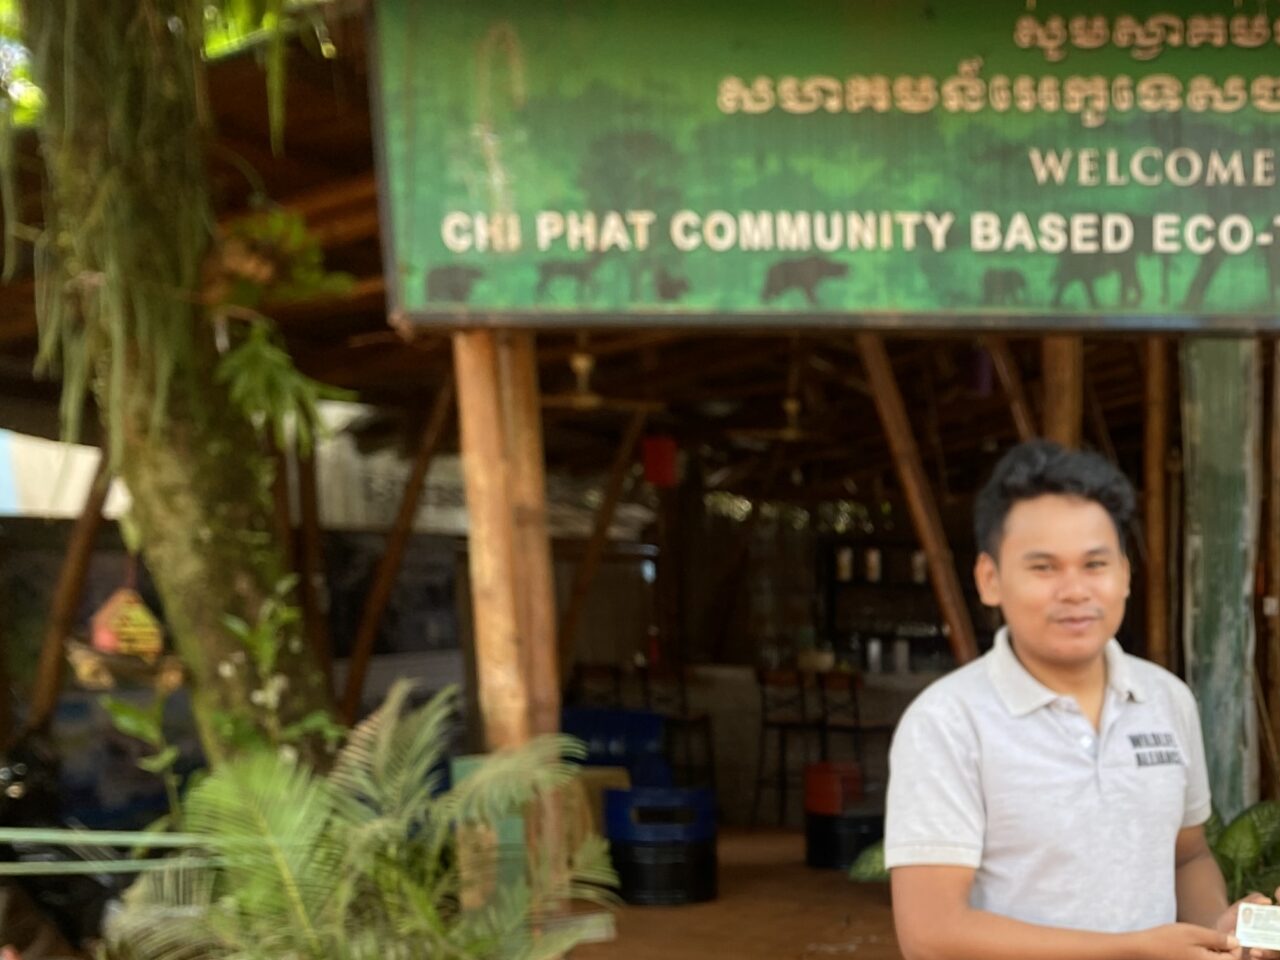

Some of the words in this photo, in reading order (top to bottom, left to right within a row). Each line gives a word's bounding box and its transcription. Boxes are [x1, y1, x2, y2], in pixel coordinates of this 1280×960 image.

[1028, 147, 1276, 188] WELCOME
[441, 210, 522, 252] CHI
[535, 209, 657, 252] PHAT
[670, 210, 955, 252] COMMUNITY
[970, 212, 1134, 253] BASED
